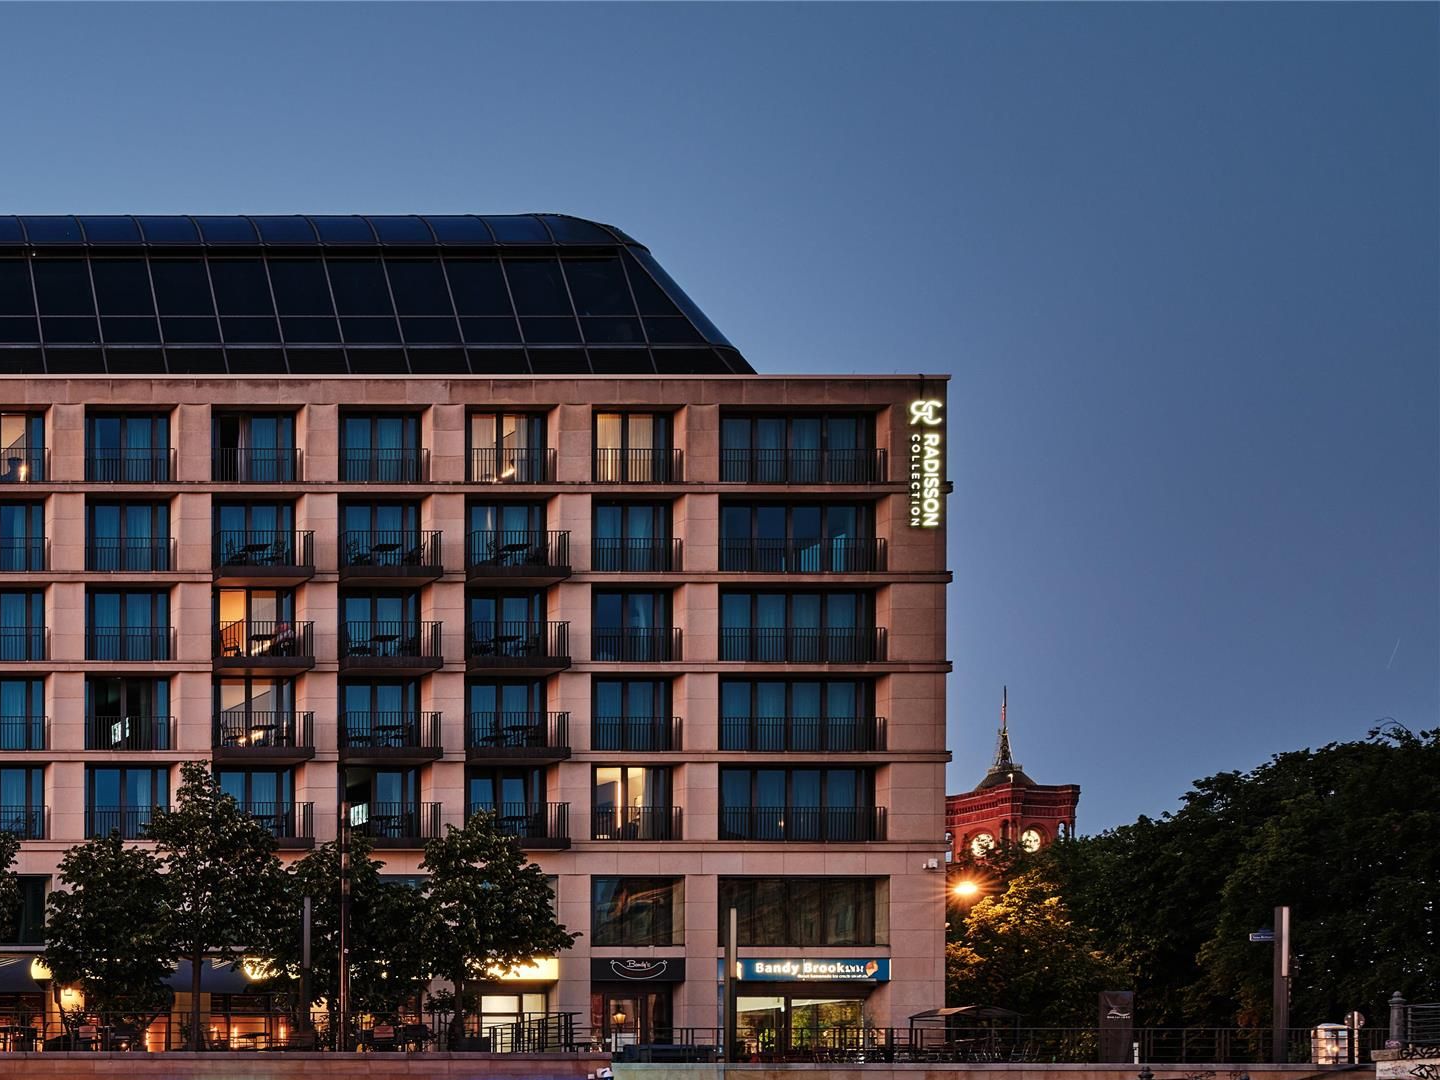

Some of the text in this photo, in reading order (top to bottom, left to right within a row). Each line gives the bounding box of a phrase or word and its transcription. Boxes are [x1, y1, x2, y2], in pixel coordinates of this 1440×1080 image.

[911, 433, 921, 526] COLLECTION
[923, 433, 940, 526] RADISSON
[755, 962, 799, 975] Bandy
